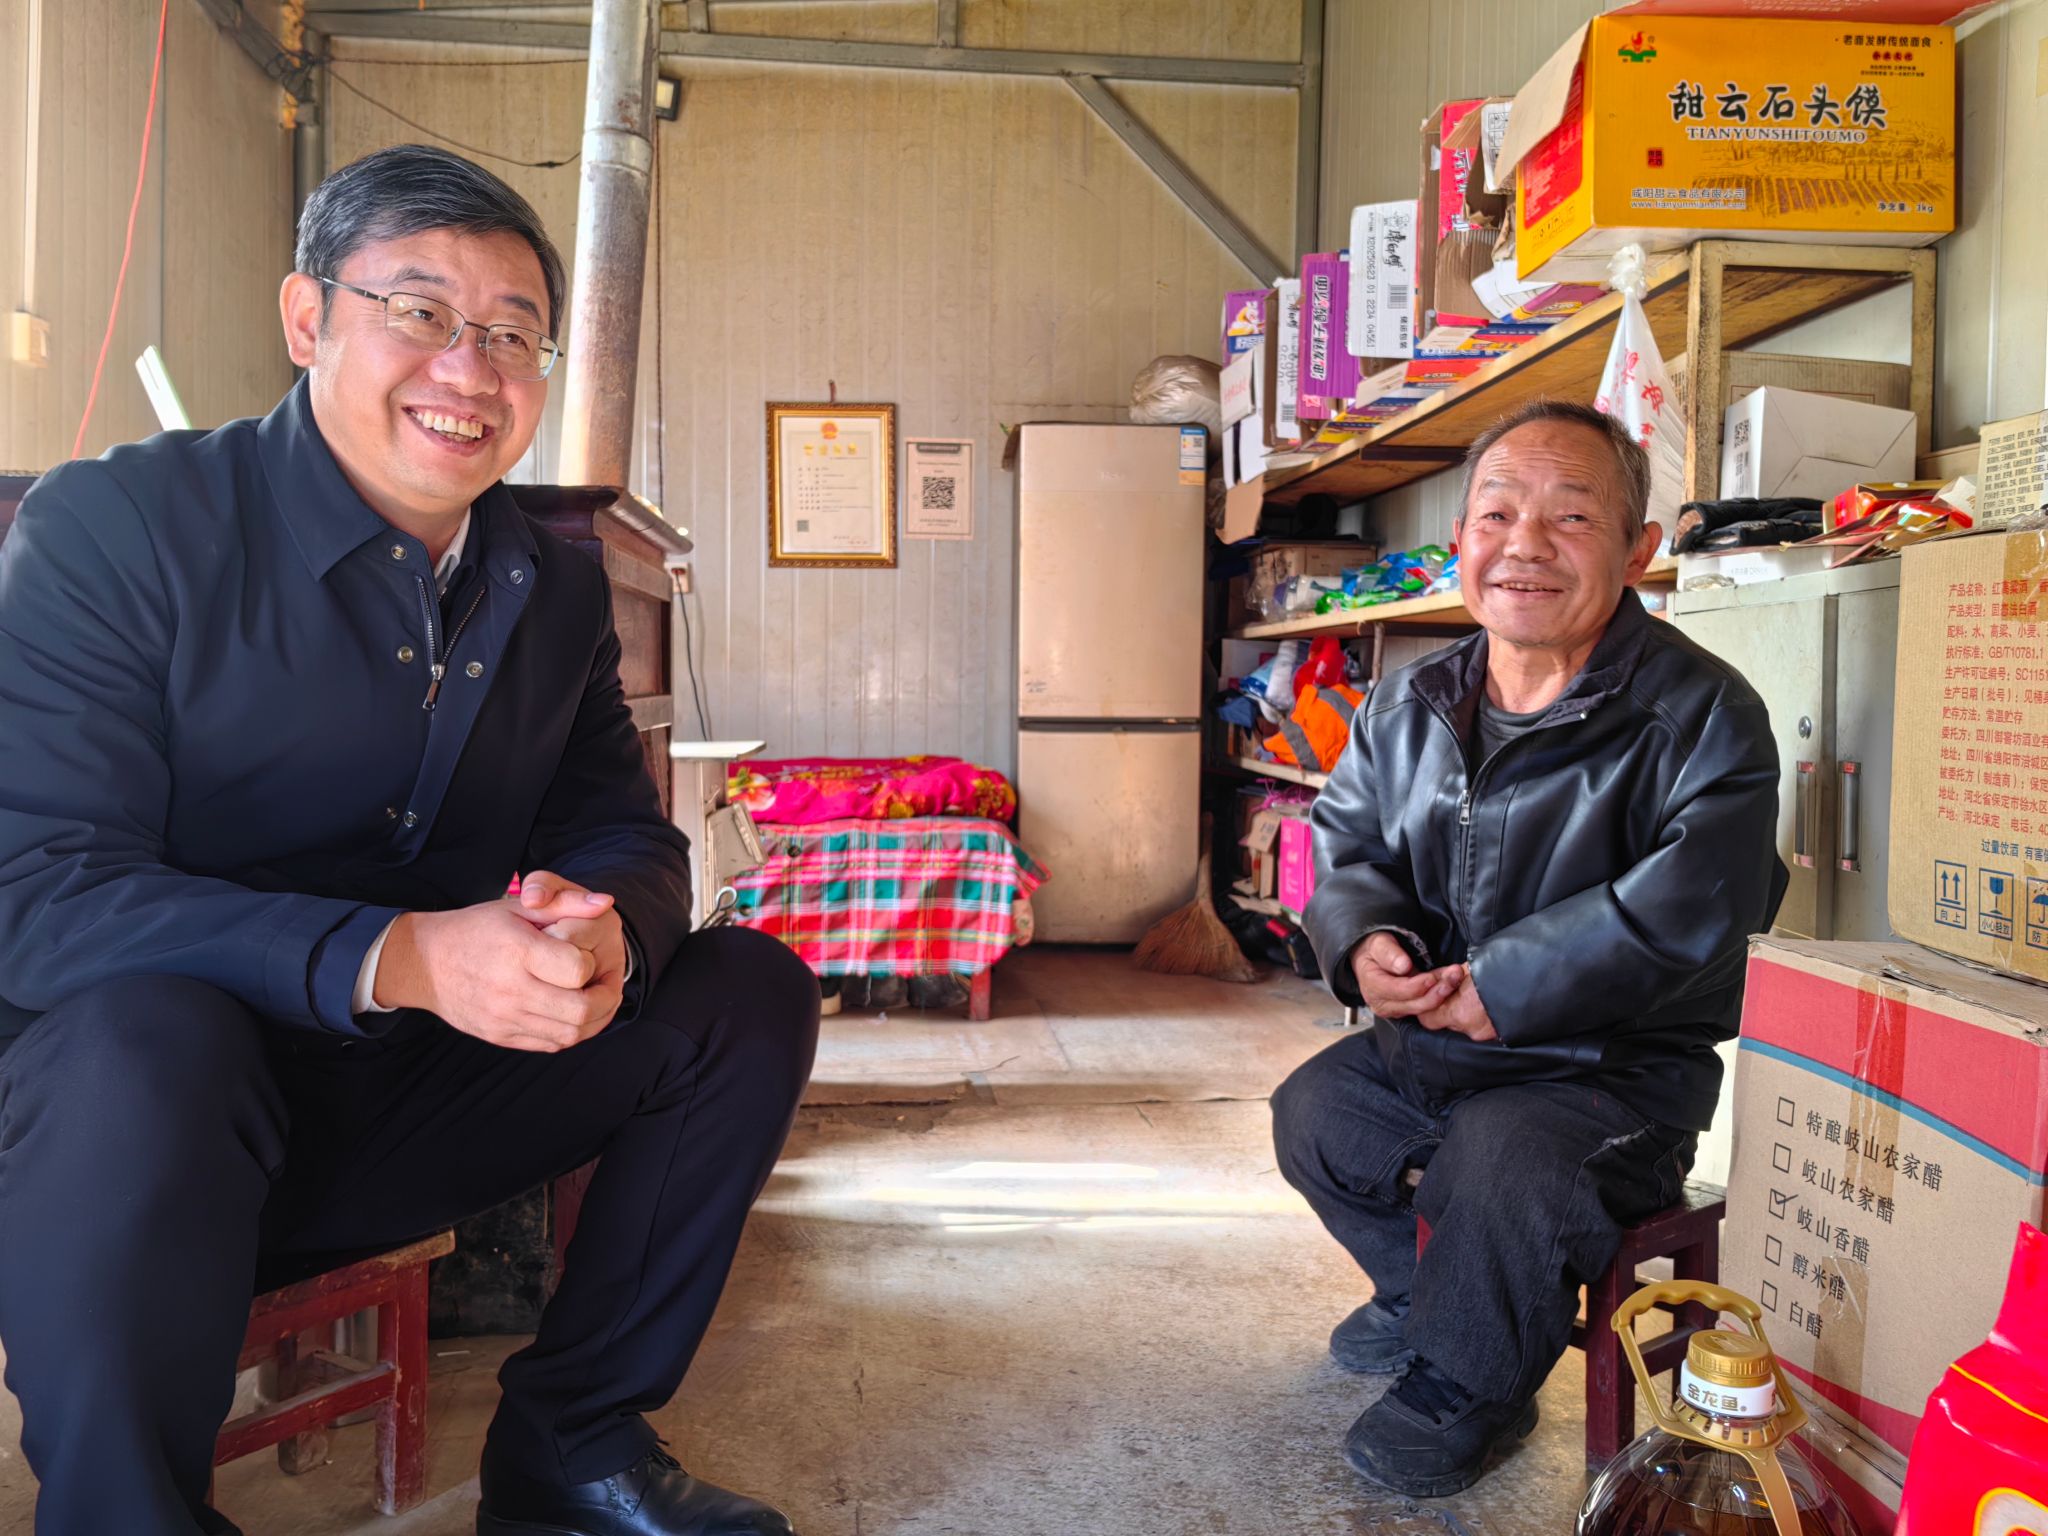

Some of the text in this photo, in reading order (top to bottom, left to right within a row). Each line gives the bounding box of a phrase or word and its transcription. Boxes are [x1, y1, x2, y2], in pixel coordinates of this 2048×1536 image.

[1668, 80, 1887, 129] 甜云石头馍
[1687, 127, 1867, 143] TIANYUNSHITOUMO
[1631, 188, 1746, 199] 咸阳甜云食品有限公司
[1981, 838, 2019, 857] 过量饮酒
[1981, 917, 2010, 935] 小心轻放
[1806, 1110, 1942, 1191] 特酿岐山农家醋
[1802, 1158, 1896, 1225] 岐山农家醋
[1797, 1205, 1870, 1264] 岐山香醋
[1792, 1252, 1846, 1301] 醇米醋
[1789, 1300, 1824, 1339] 白醋
[1687, 1383, 1739, 1412] 金龙鱼
